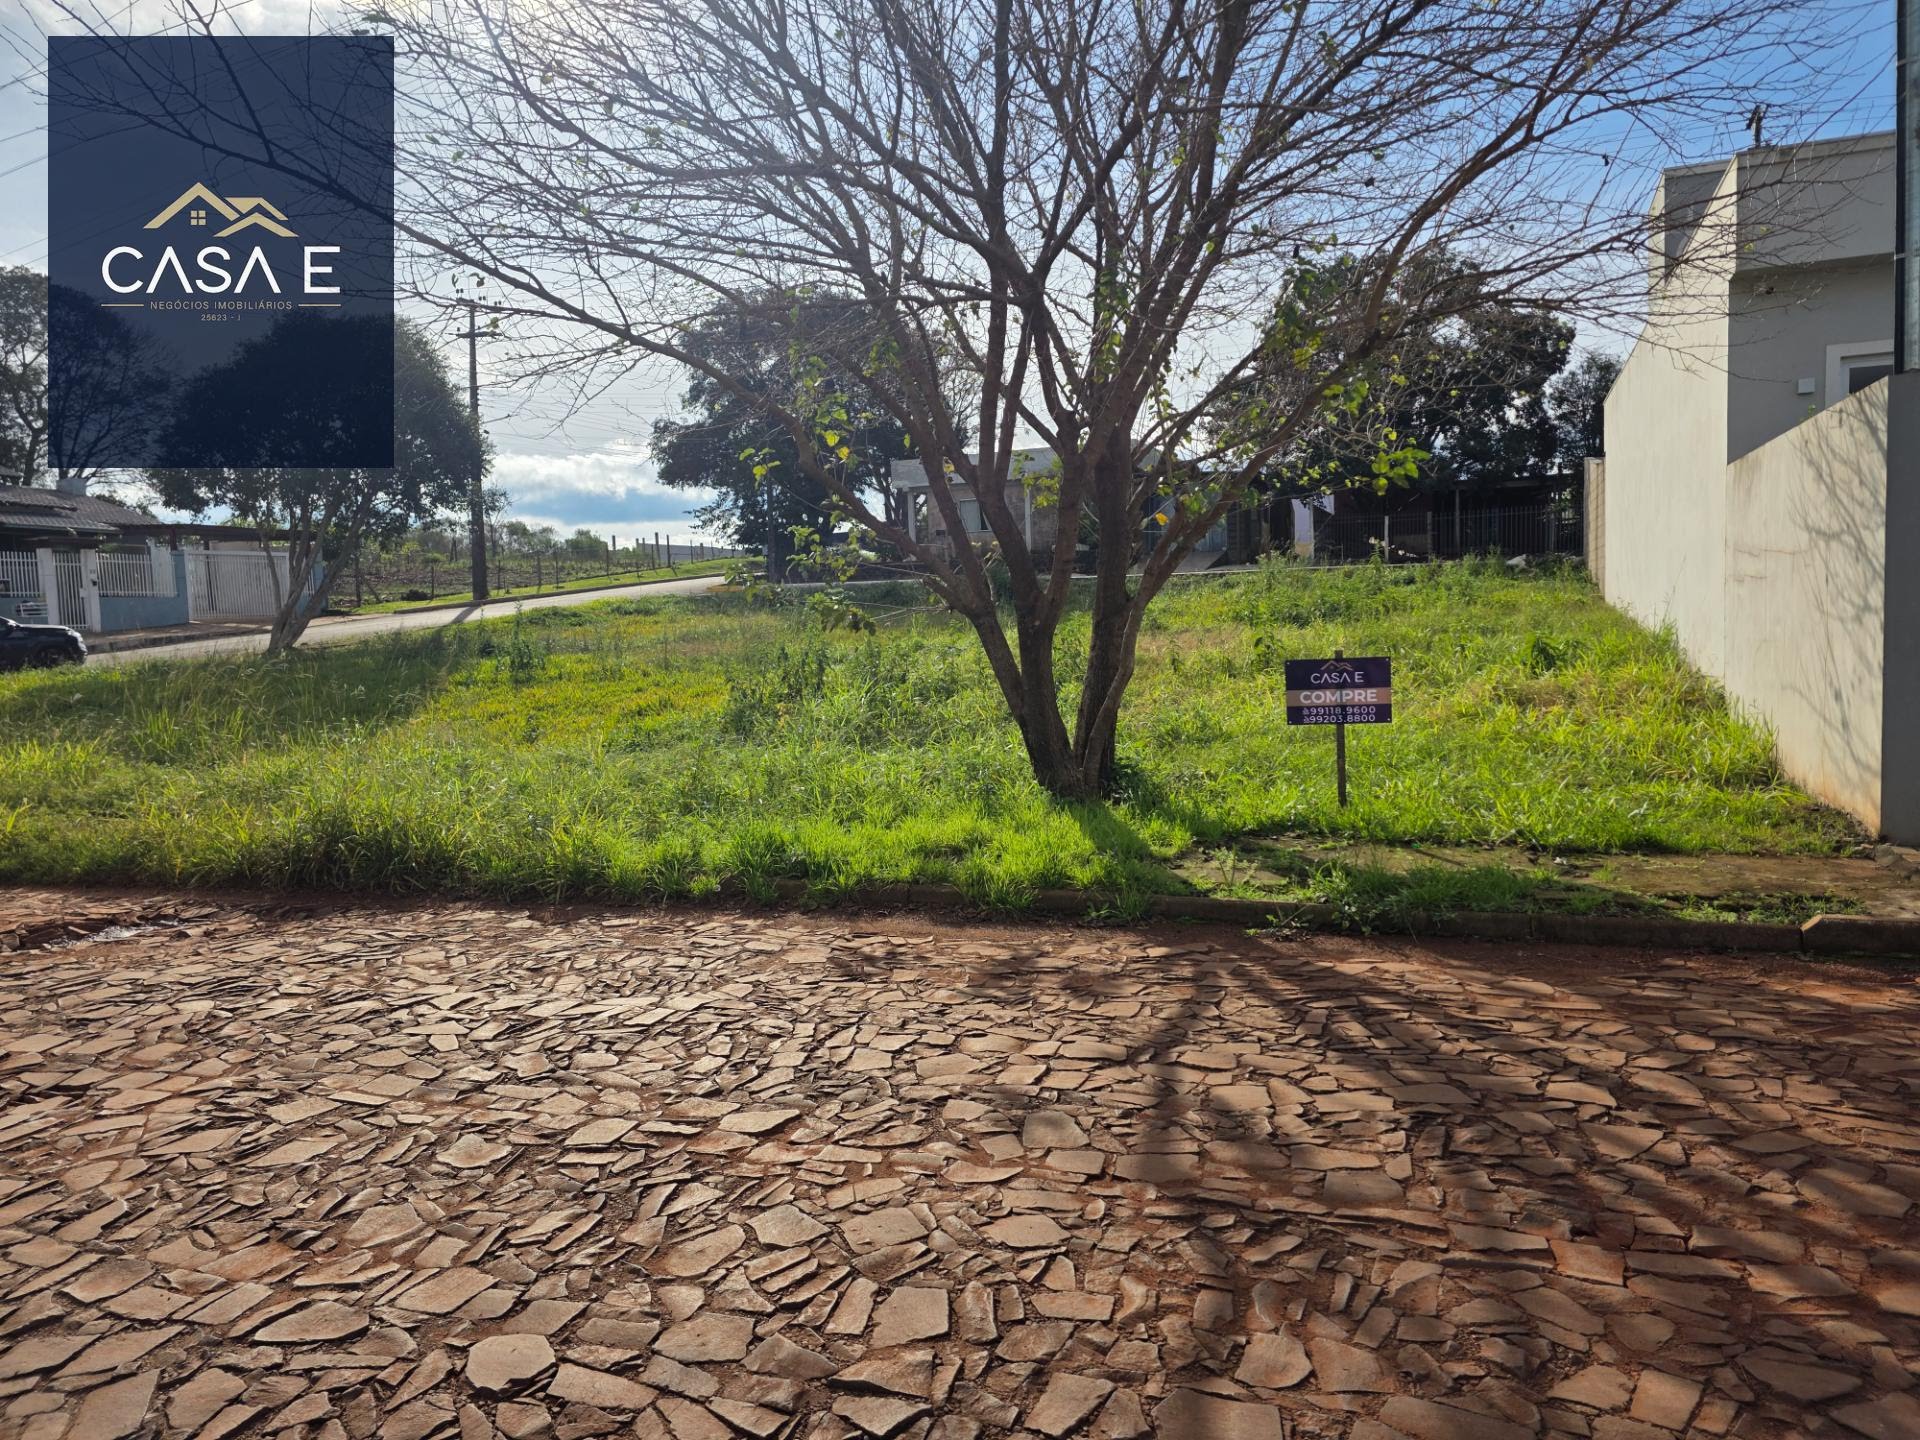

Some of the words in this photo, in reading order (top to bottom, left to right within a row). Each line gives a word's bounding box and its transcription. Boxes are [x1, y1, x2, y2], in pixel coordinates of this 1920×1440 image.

[1310, 673, 1351, 684] CASA
[1354, 671, 1365, 683] E
[1299, 689, 1378, 704] COMPRE
[1310, 706, 1376, 715] 99118.9600
[1309, 714, 1376, 723] 99203.8800
